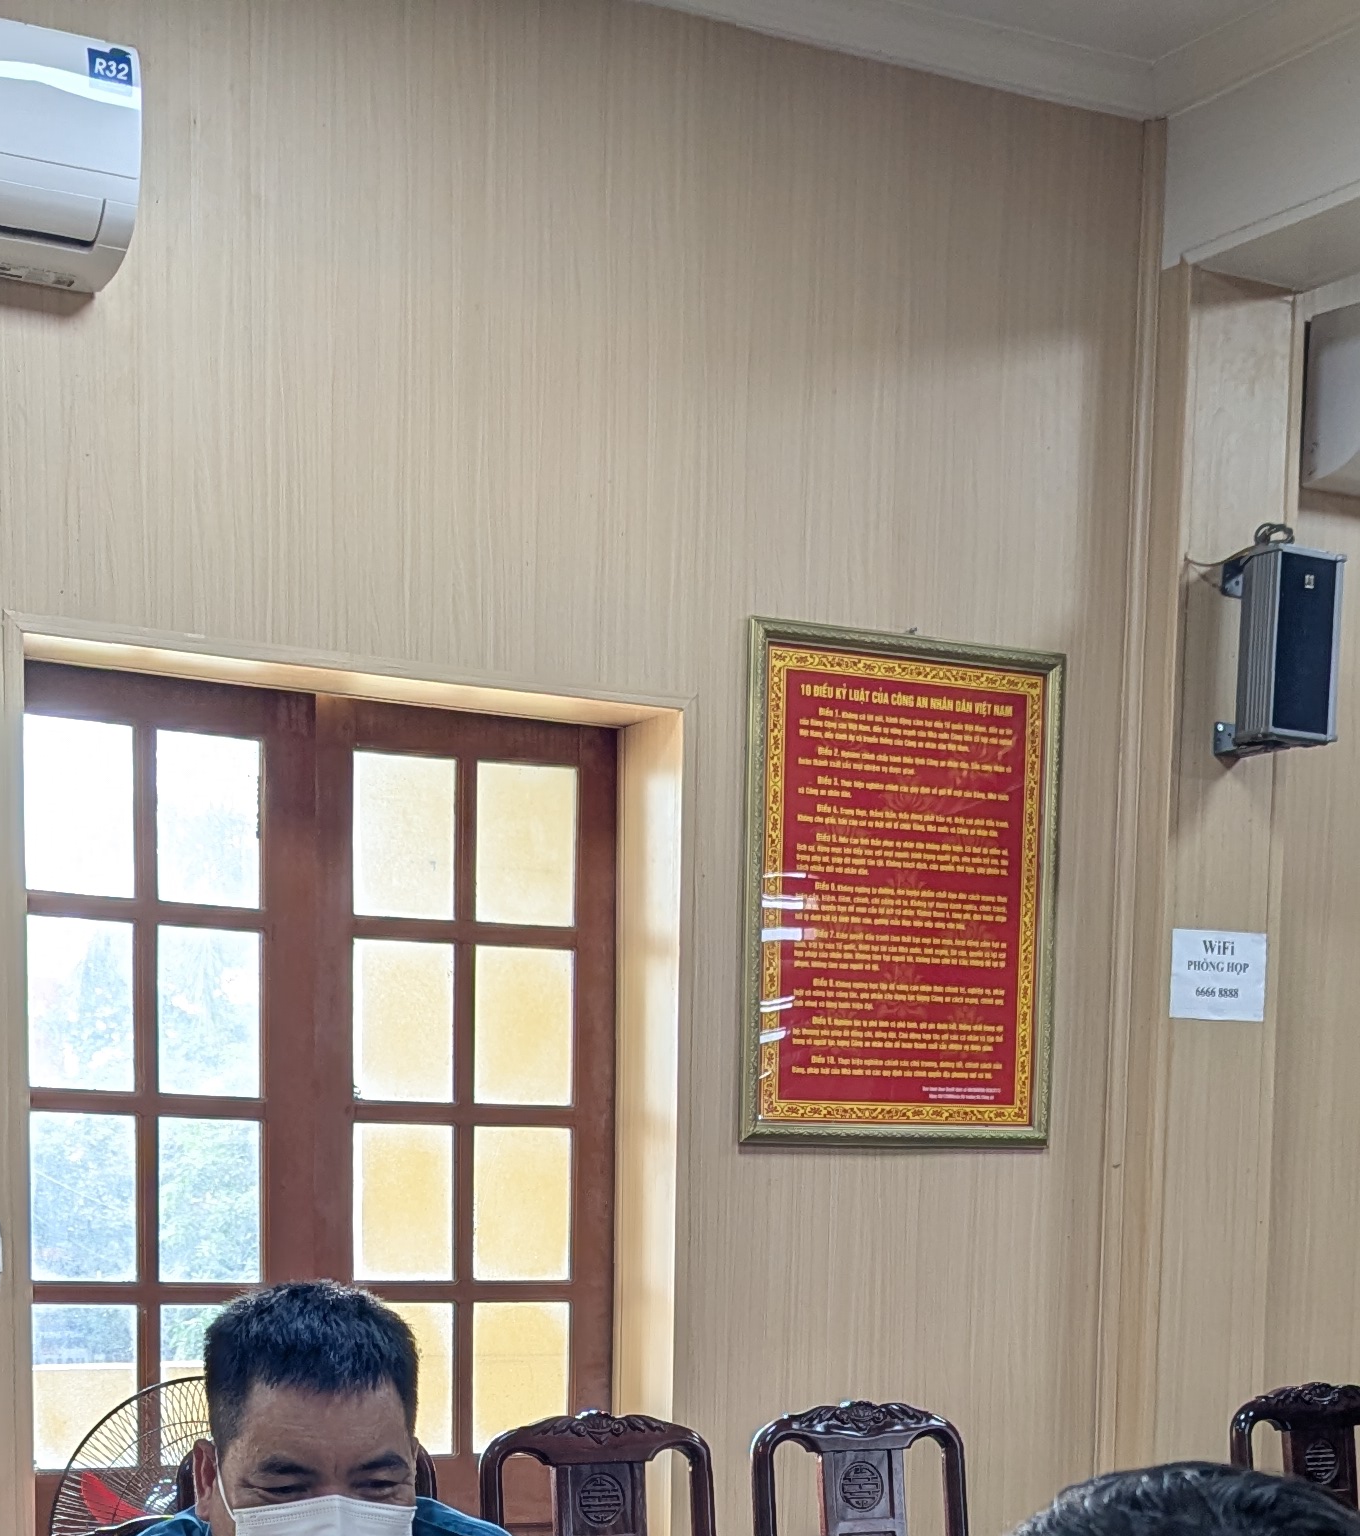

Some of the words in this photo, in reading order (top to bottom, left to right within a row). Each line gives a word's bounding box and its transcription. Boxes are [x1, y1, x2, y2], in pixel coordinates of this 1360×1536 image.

[94, 57, 129, 81] R32
[848, 687, 871, 705] LUẬT
[871, 687, 890, 705] CỦA
[890, 691, 915, 708] CÔNG
[974, 701, 992, 718] VIỆT
[1202, 939, 1235, 956] WiFi
[1187, 957, 1225, 973] PHÒNG
[1226, 961, 1250, 975] HỌP
[1195, 986, 1216, 998] 6666
